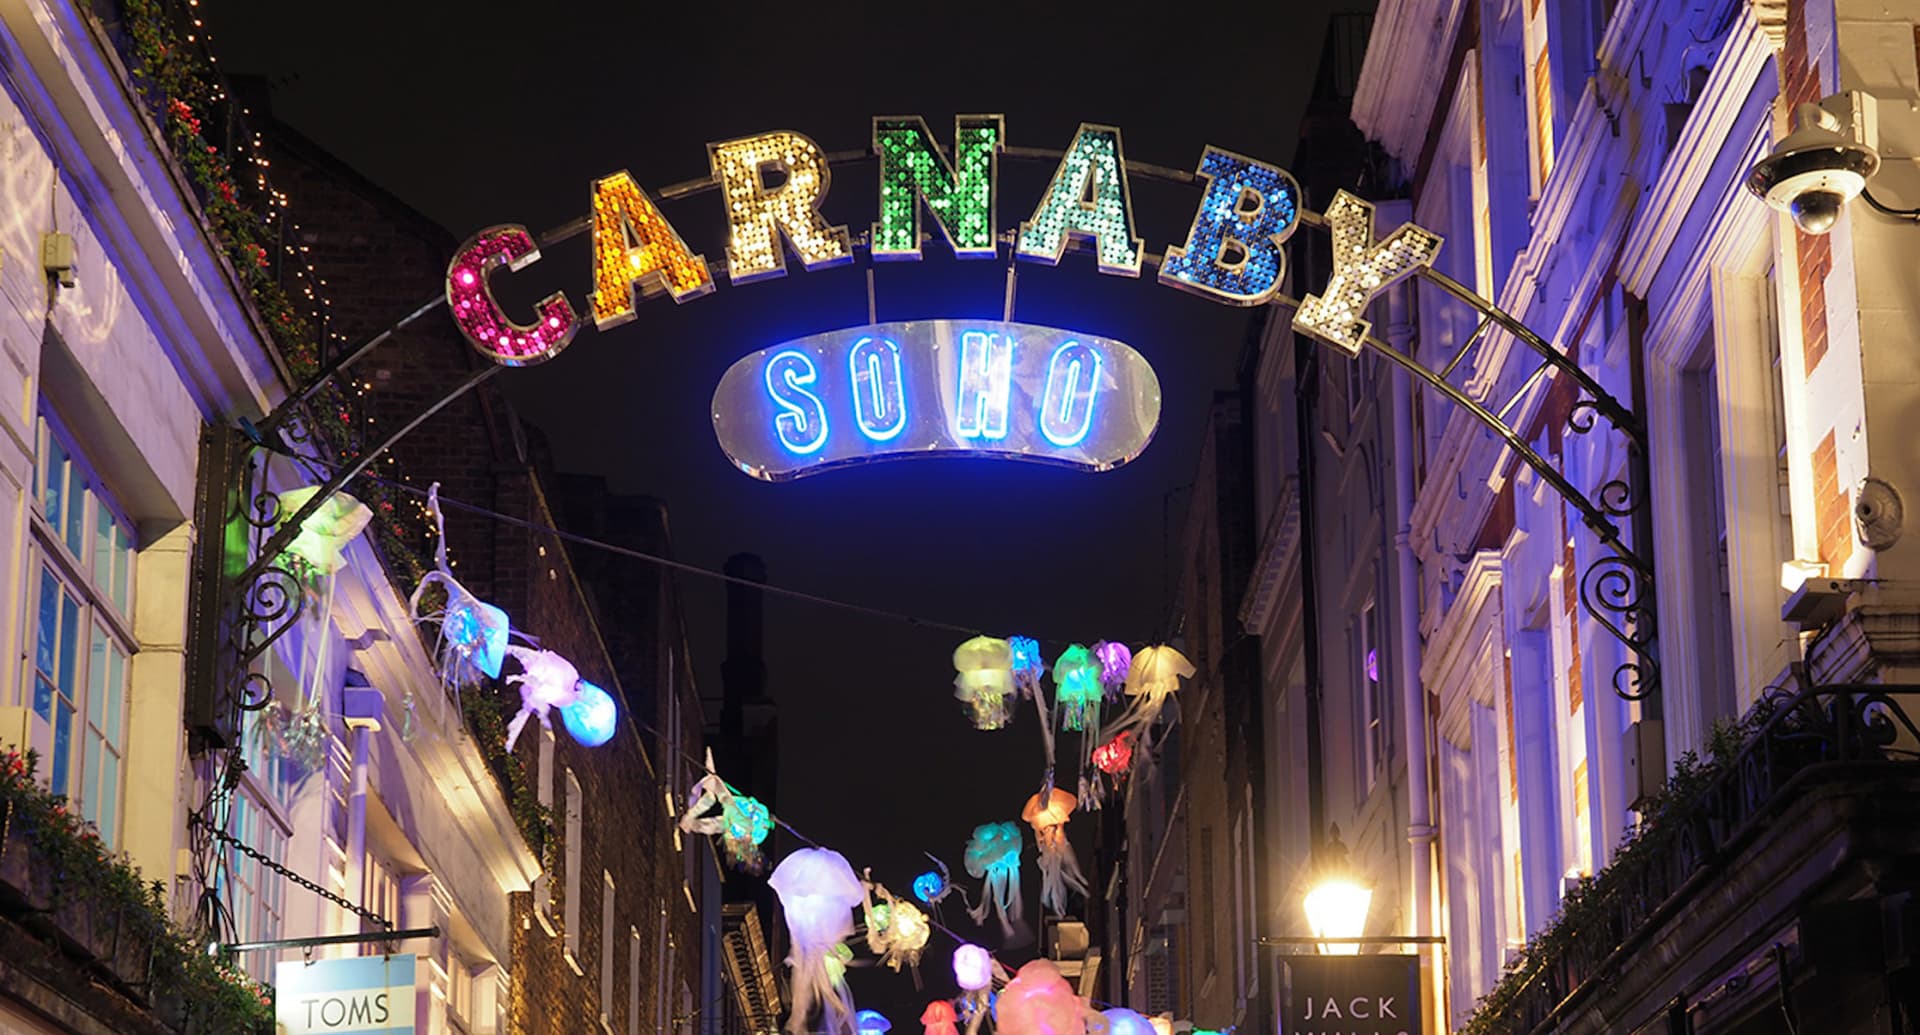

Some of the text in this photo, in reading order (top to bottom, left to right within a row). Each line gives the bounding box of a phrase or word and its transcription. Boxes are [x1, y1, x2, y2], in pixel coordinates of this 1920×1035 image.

[446, 114, 1443, 367] CARNABY
[765, 331, 1103, 454] SOHO
[301, 994, 389, 1028] TOMS
[1304, 997, 1397, 1020] JACK
